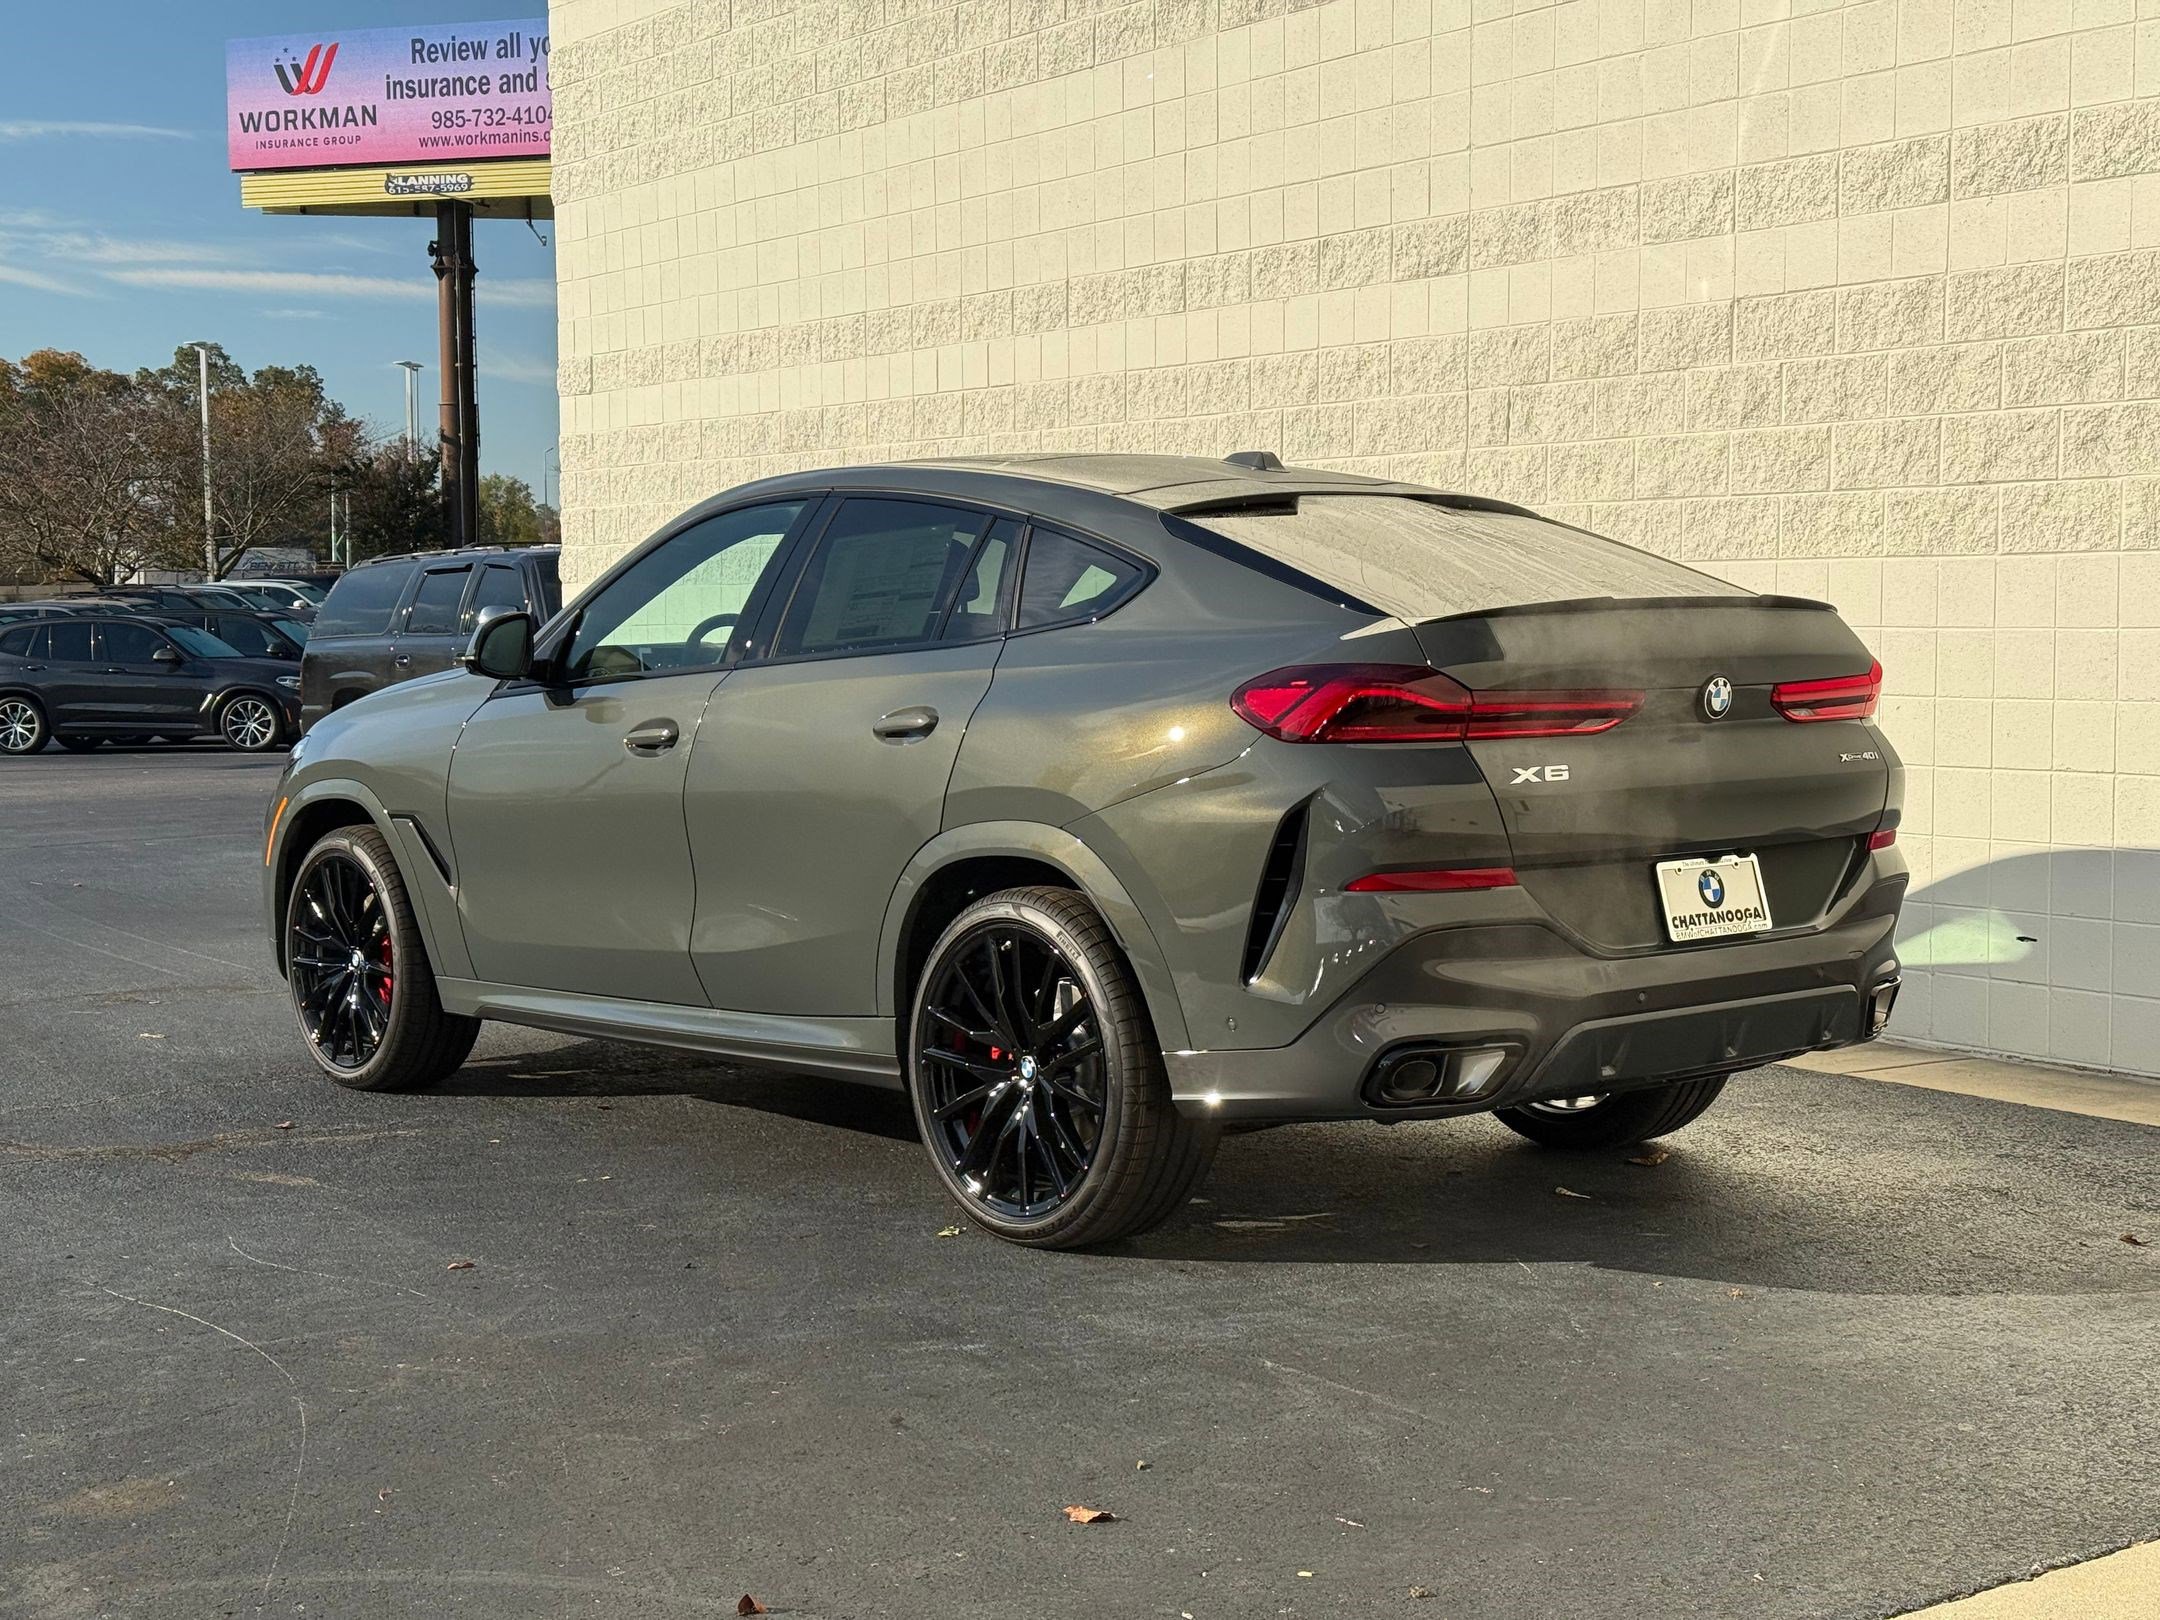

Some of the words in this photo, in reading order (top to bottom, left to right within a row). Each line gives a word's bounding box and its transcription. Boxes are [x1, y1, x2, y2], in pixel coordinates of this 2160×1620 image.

[411, 35, 488, 64] Review
[496, 31, 521, 58] all
[386, 74, 491, 100] insurance
[499, 66, 538, 94] and
[239, 105, 377, 133] WORKMAN
[255, 137, 319, 150] INSURANCE
[323, 135, 361, 147] GROUP
[1509, 764, 1570, 785] X6
[1671, 906, 1762, 930] CHATTANOOGA
